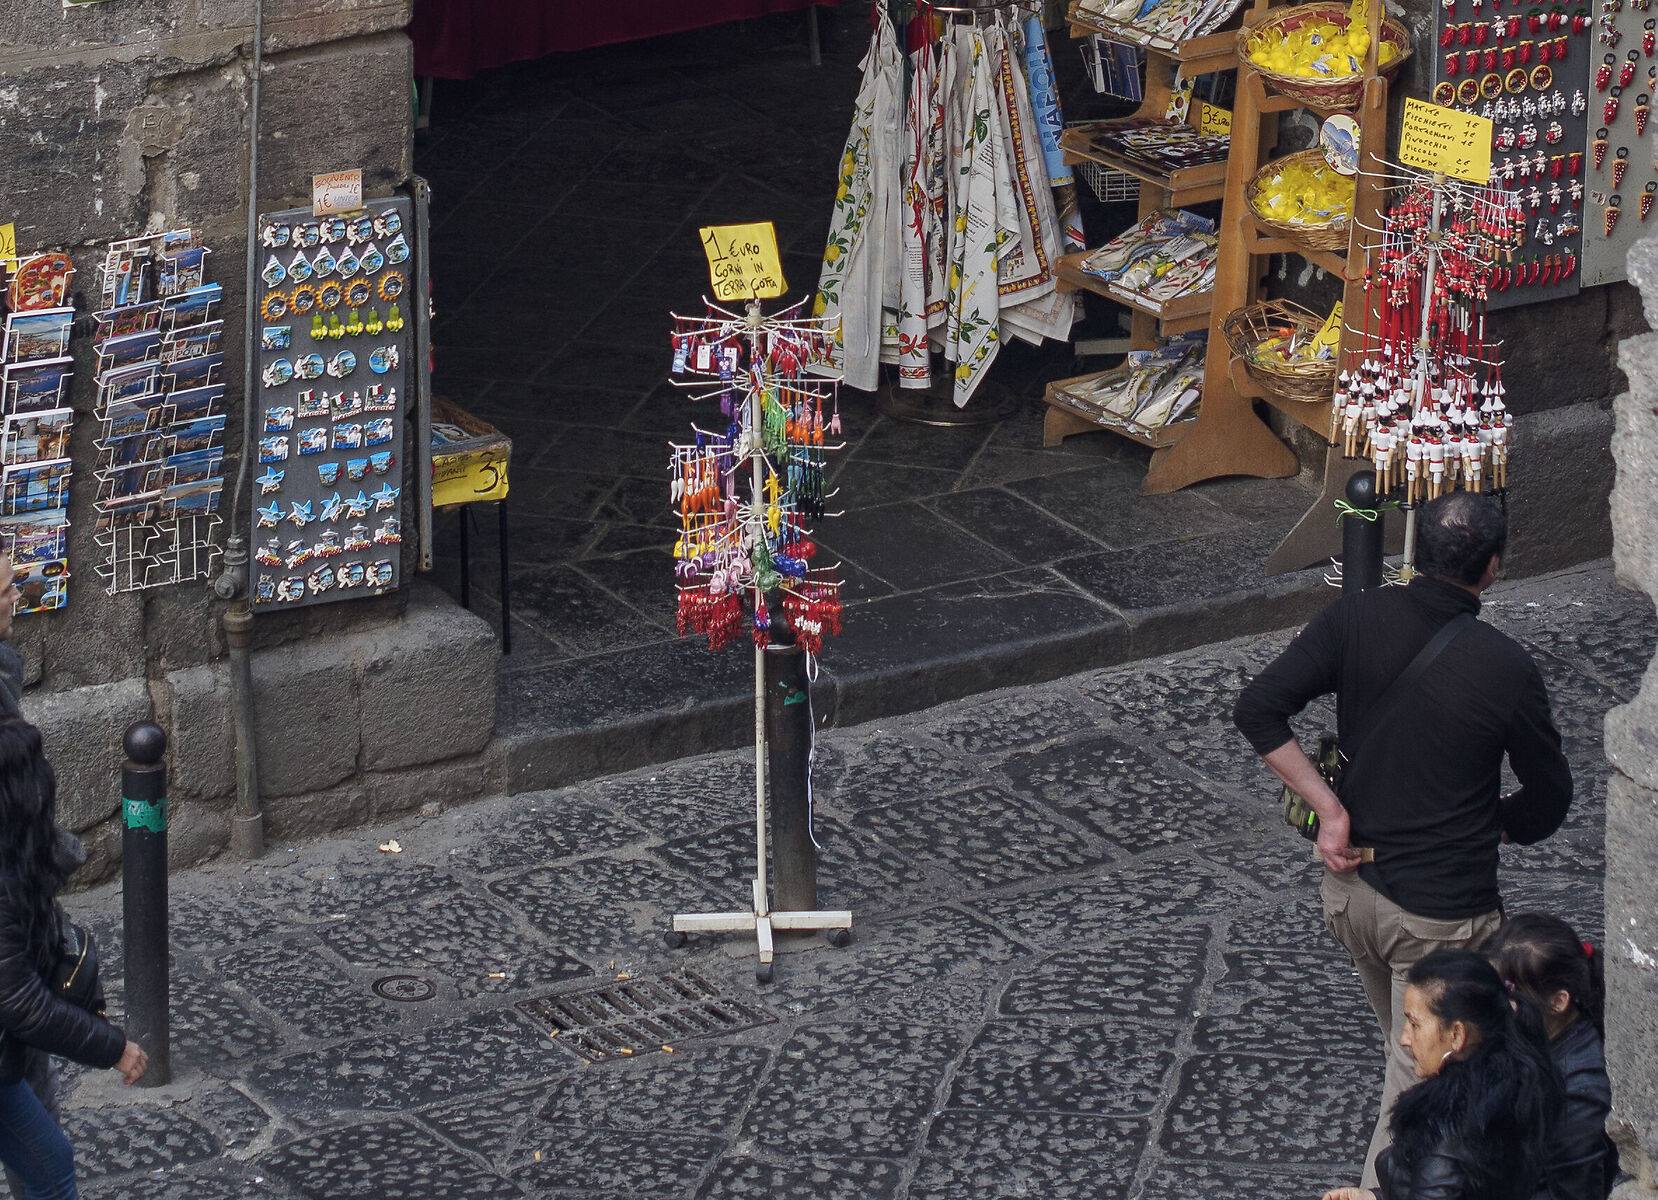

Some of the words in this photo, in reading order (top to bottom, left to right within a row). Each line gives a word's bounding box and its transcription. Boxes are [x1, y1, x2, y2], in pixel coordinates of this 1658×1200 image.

[1406, 144, 1438, 158] PICCOLO
[704, 230, 728, 262] 1
[714, 263, 744, 278] CORNI
[754, 262, 764, 274] IN
[713, 278, 747, 297] TERRA
[750, 276, 778, 291] COTTA
